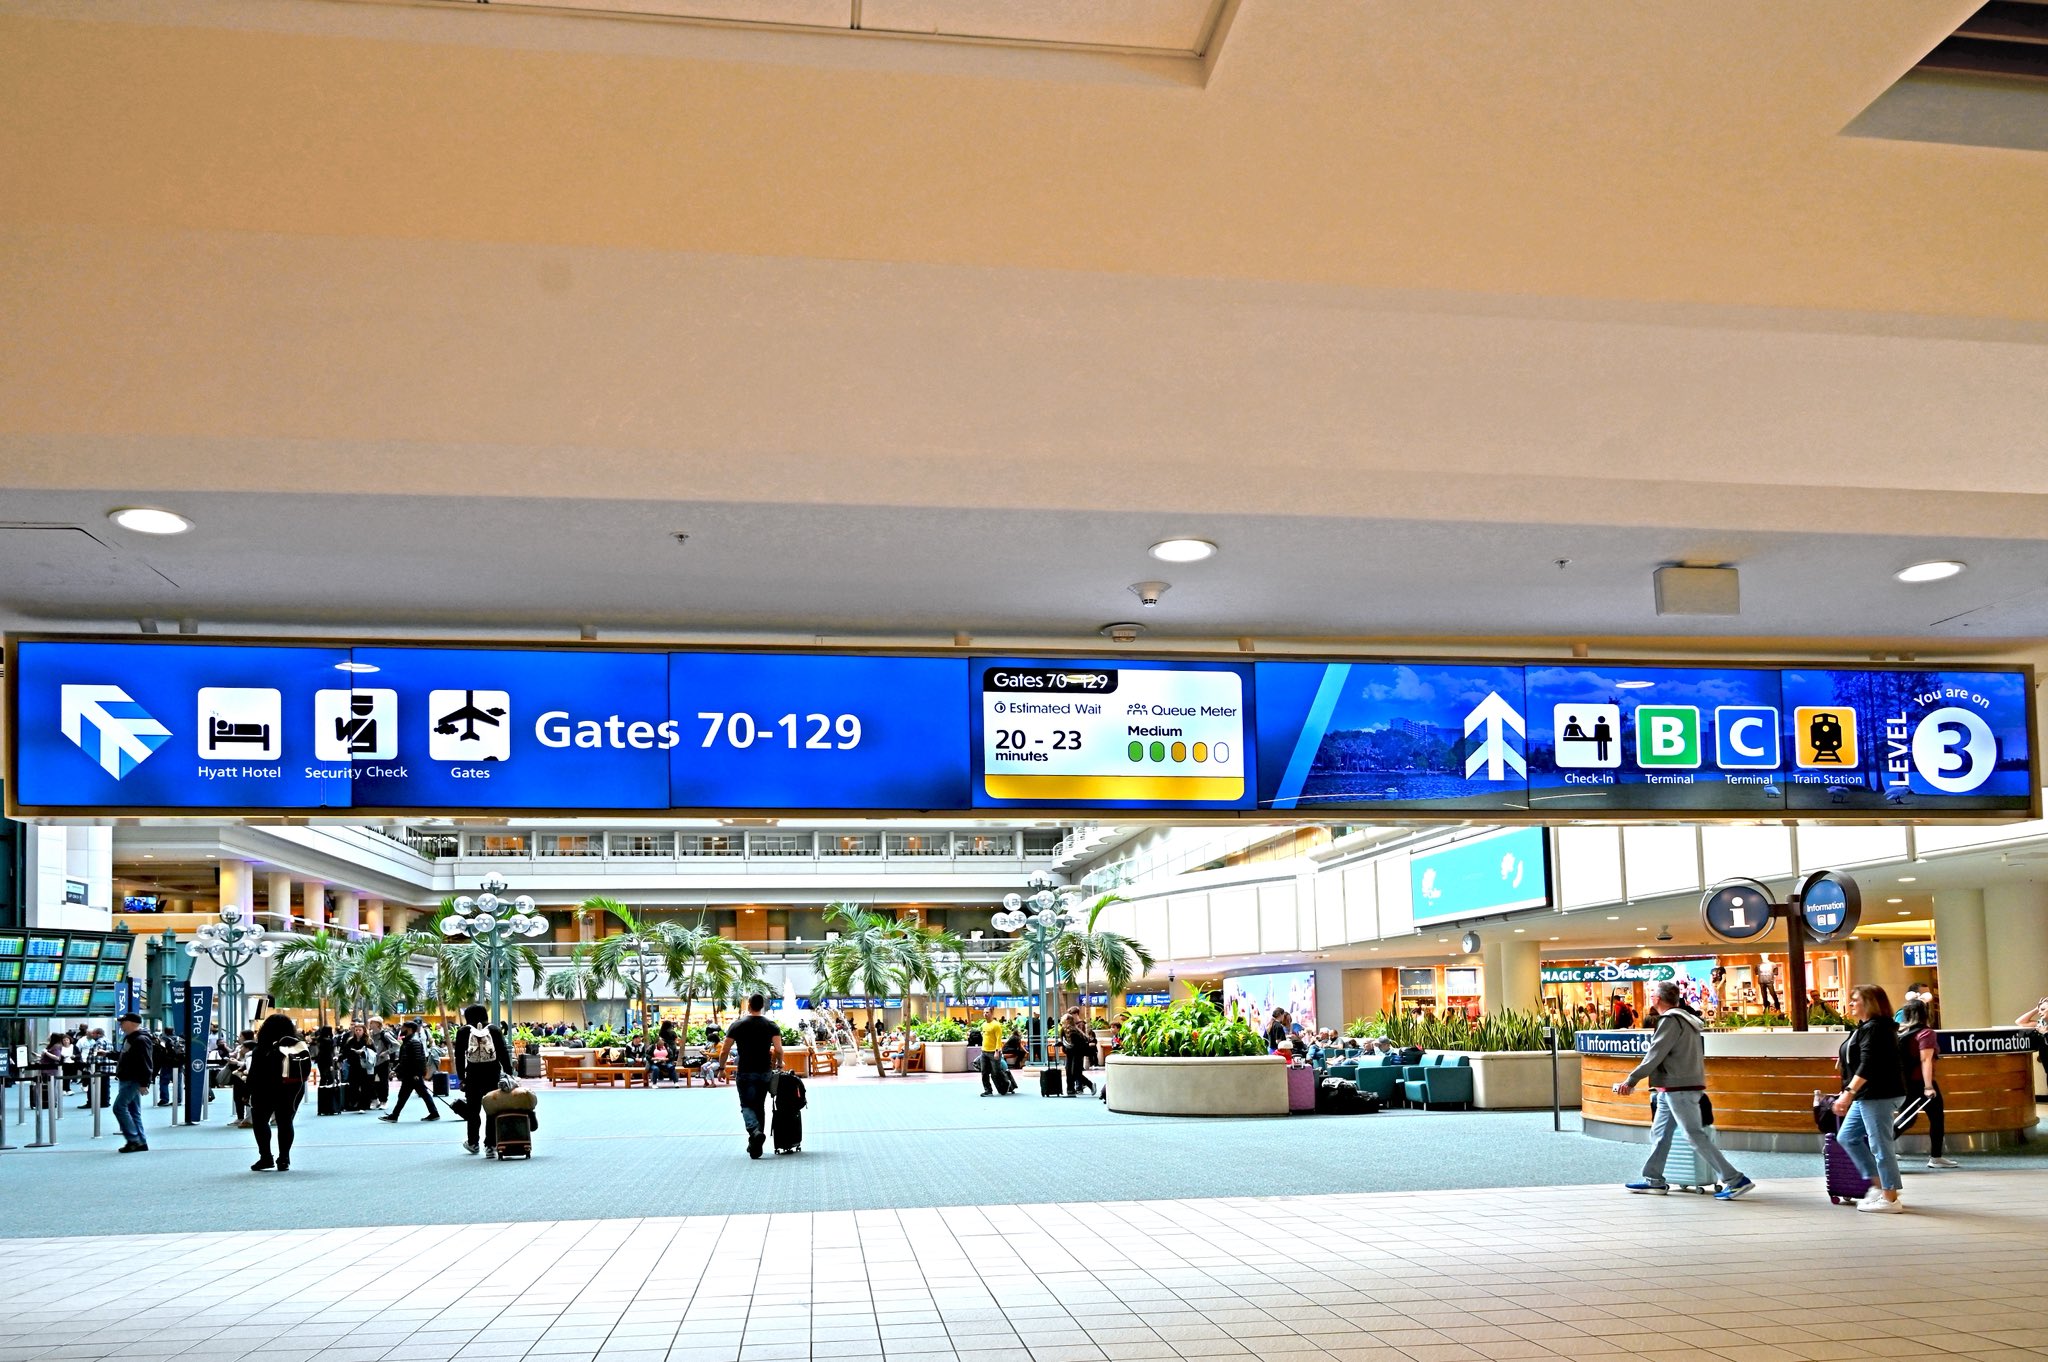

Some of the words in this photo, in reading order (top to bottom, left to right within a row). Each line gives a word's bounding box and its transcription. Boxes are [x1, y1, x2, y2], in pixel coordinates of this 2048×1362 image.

[993, 672, 1043, 688] Gates
[1914, 690, 1942, 707] You
[1946, 688, 1968, 699] are
[1972, 694, 1990, 708] on
[1010, 702, 1070, 714] Estimated
[1075, 703, 1102, 714] Wait
[1152, 704, 1196, 716] Queue
[1200, 705, 1237, 717] Meter
[534, 710, 680, 750] Gates
[697, 712, 862, 750] 70-129
[1128, 725, 1182, 737] Medium
[1651, 716, 1685, 756] B
[1729, 717, 1764, 757] C
[995, 729, 1026, 750] 20
[1052, 730, 1082, 750] 23
[1886, 711, 1909, 786] LEVEL
[1937, 721, 1973, 779] 3
[995, 750, 1048, 762] minutes
[198, 766, 238, 779] Hyatt
[243, 766, 281, 778] Hotel
[305, 767, 364, 780] Security
[367, 766, 408, 779] Check
[450, 767, 490, 778] Gates
[1564, 773, 1614, 784] Check-In
[1645, 774, 1694, 784] Terminal
[1725, 774, 1773, 784] Terminal
[1793, 774, 1821, 784] Train
[1823, 774, 1862, 785] Station
[1806, 901, 1844, 913] Information
[1541, 970, 1581, 981] MAGIC
[1584, 972, 1596, 980] OF
[193, 991, 204, 1013] TSA
[193, 1015, 204, 1035] Pre
[1587, 1035, 1651, 1052] Informatio
[1950, 1033, 2031, 1052] Information
